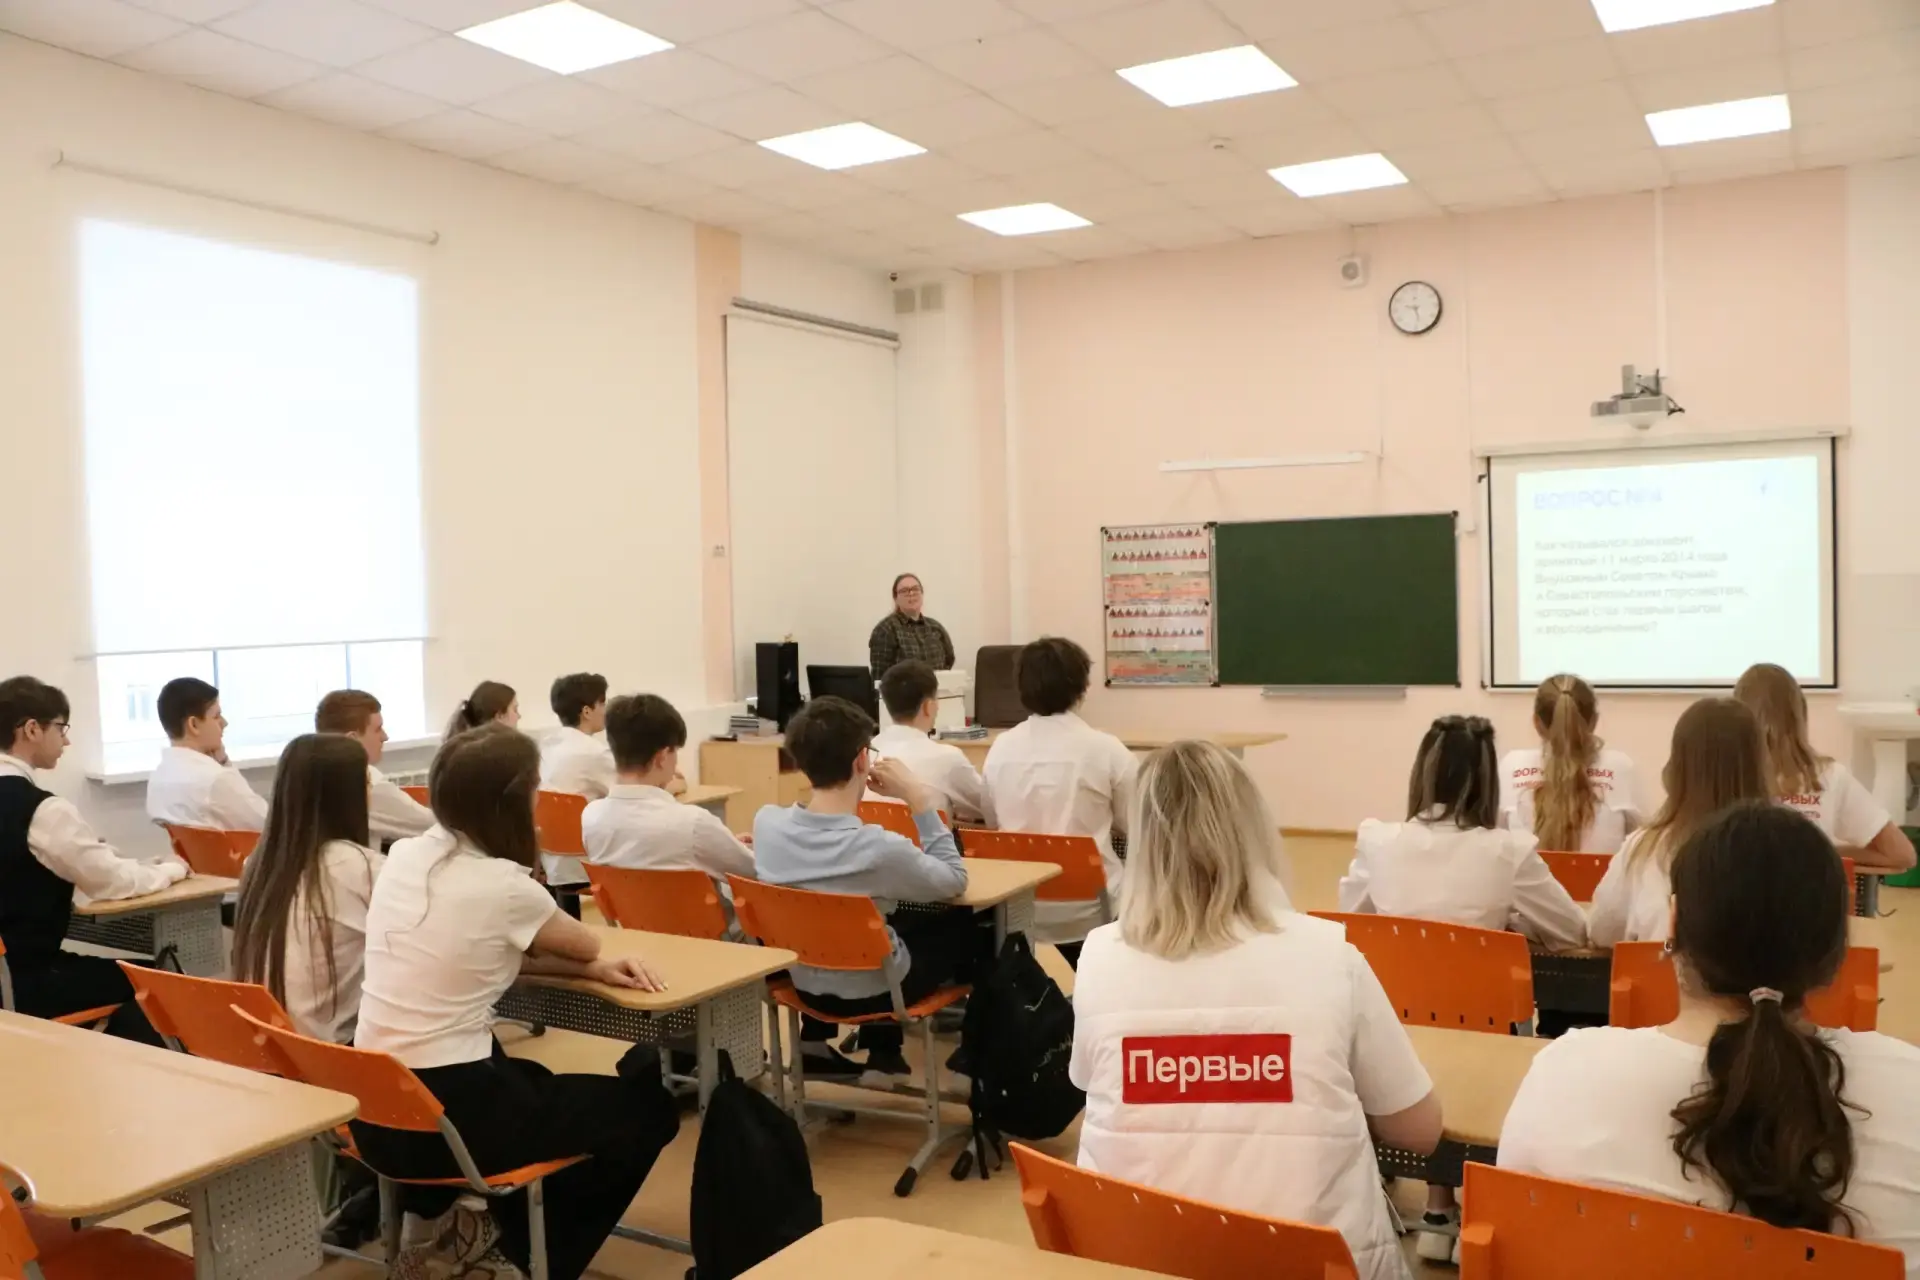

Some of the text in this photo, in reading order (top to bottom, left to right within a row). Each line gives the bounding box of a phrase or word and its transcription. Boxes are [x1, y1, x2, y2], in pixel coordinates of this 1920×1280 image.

[1534, 489, 1622, 509] ВОПРОС
[1661, 551, 1694, 563] 2014
[1128, 1049, 1285, 1093] Первые
